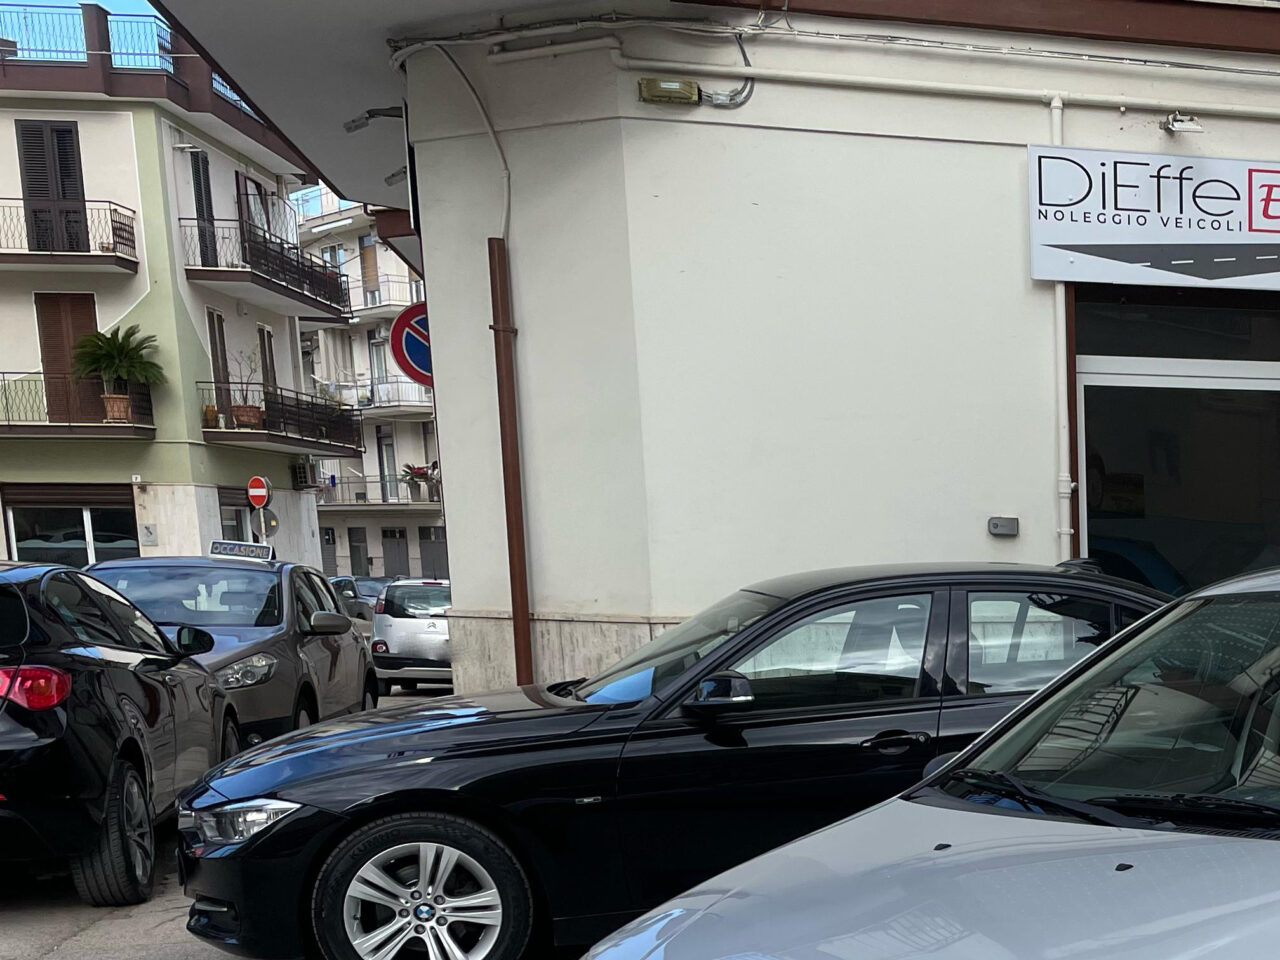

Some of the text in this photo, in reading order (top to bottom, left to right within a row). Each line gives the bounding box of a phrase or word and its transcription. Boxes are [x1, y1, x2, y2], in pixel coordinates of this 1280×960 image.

[1037, 155, 1241, 217] DiEffe
[1037, 208, 1243, 232] NOLEGGIO VEICOLI
[212, 543, 270, 558] OCCASIONE
